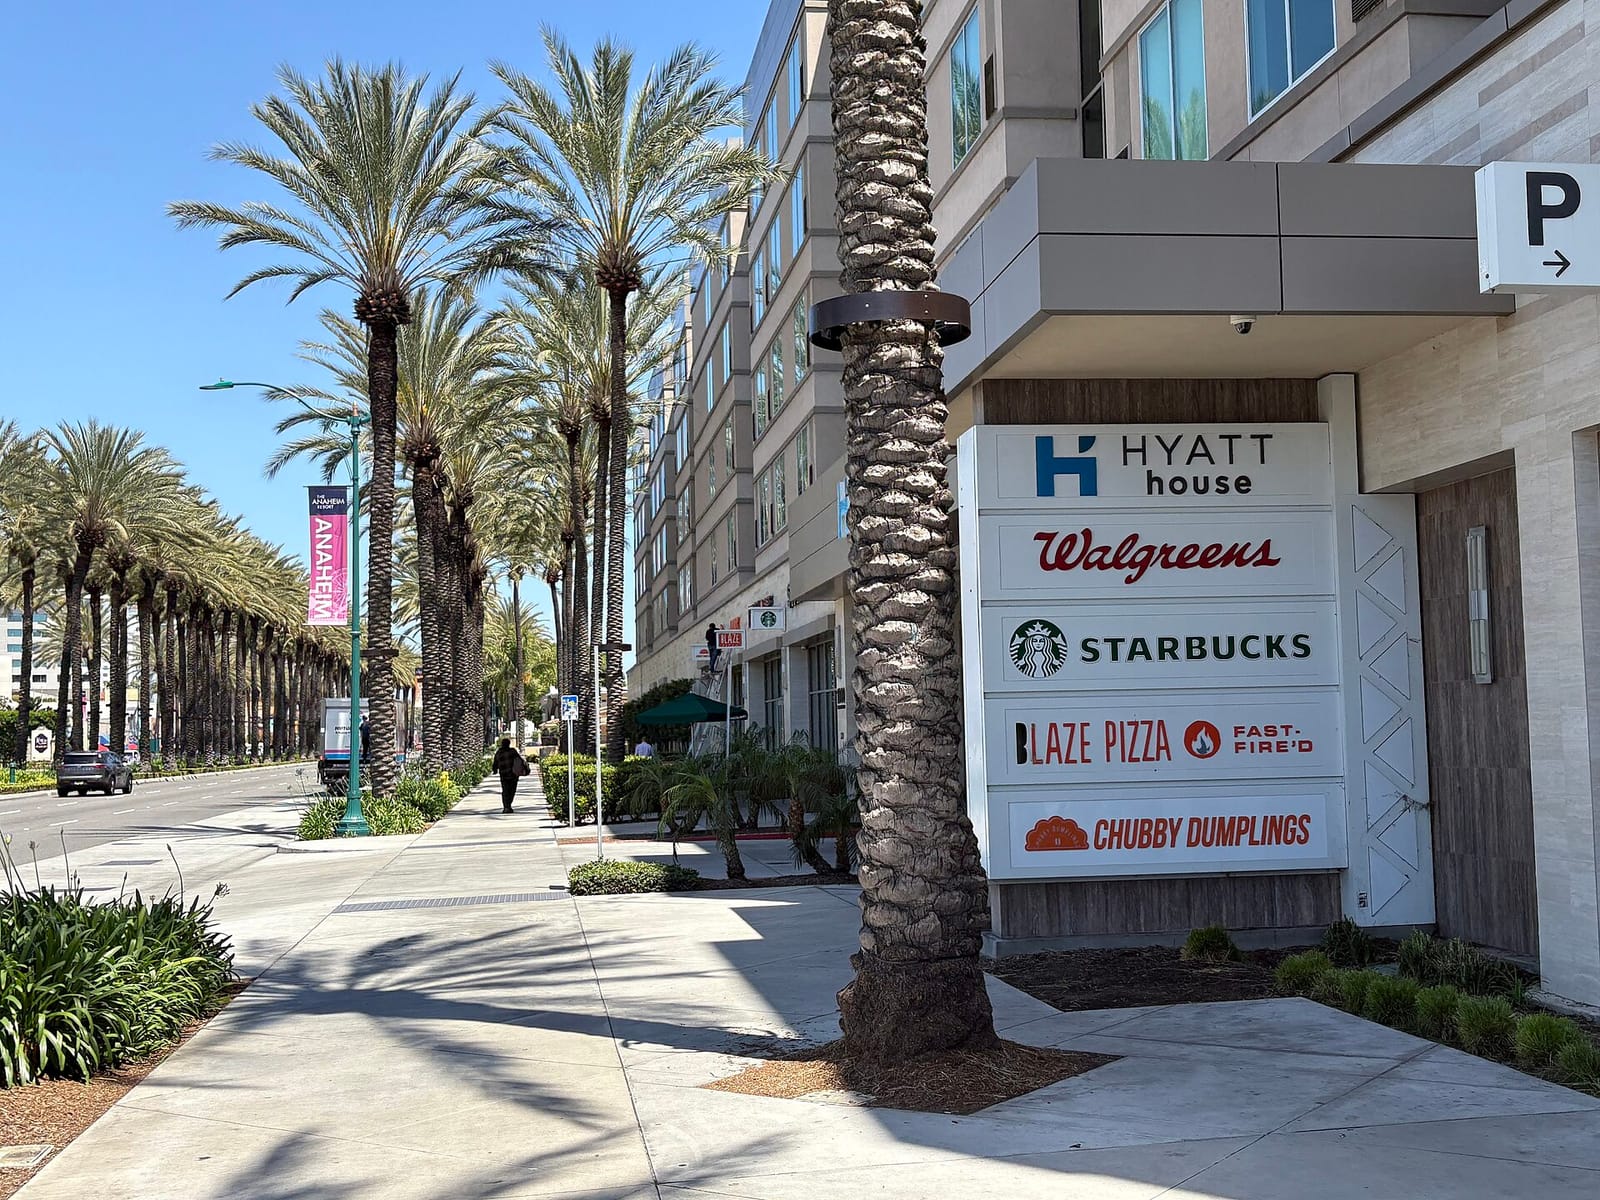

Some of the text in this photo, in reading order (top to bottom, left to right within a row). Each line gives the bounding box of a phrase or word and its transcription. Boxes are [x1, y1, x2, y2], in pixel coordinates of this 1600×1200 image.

[1526, 171, 1581, 246] P
[1122, 434, 1273, 467] HYATT
[1146, 469, 1252, 495] house
[312, 497, 345, 505] ANAHEIM
[315, 517, 333, 619] ANAHEIM
[1034, 528, 1281, 584] Walgreens
[1081, 634, 1312, 662] STARBUCKS
[1015, 719, 1172, 764] BLAZE PIZZA
[1234, 724, 1301, 737] FAST-
[1234, 740, 1313, 754] FIRE'D
[1093, 817, 1183, 850] CHUBBY
[1186, 814, 1311, 847] DUMPLINGS
